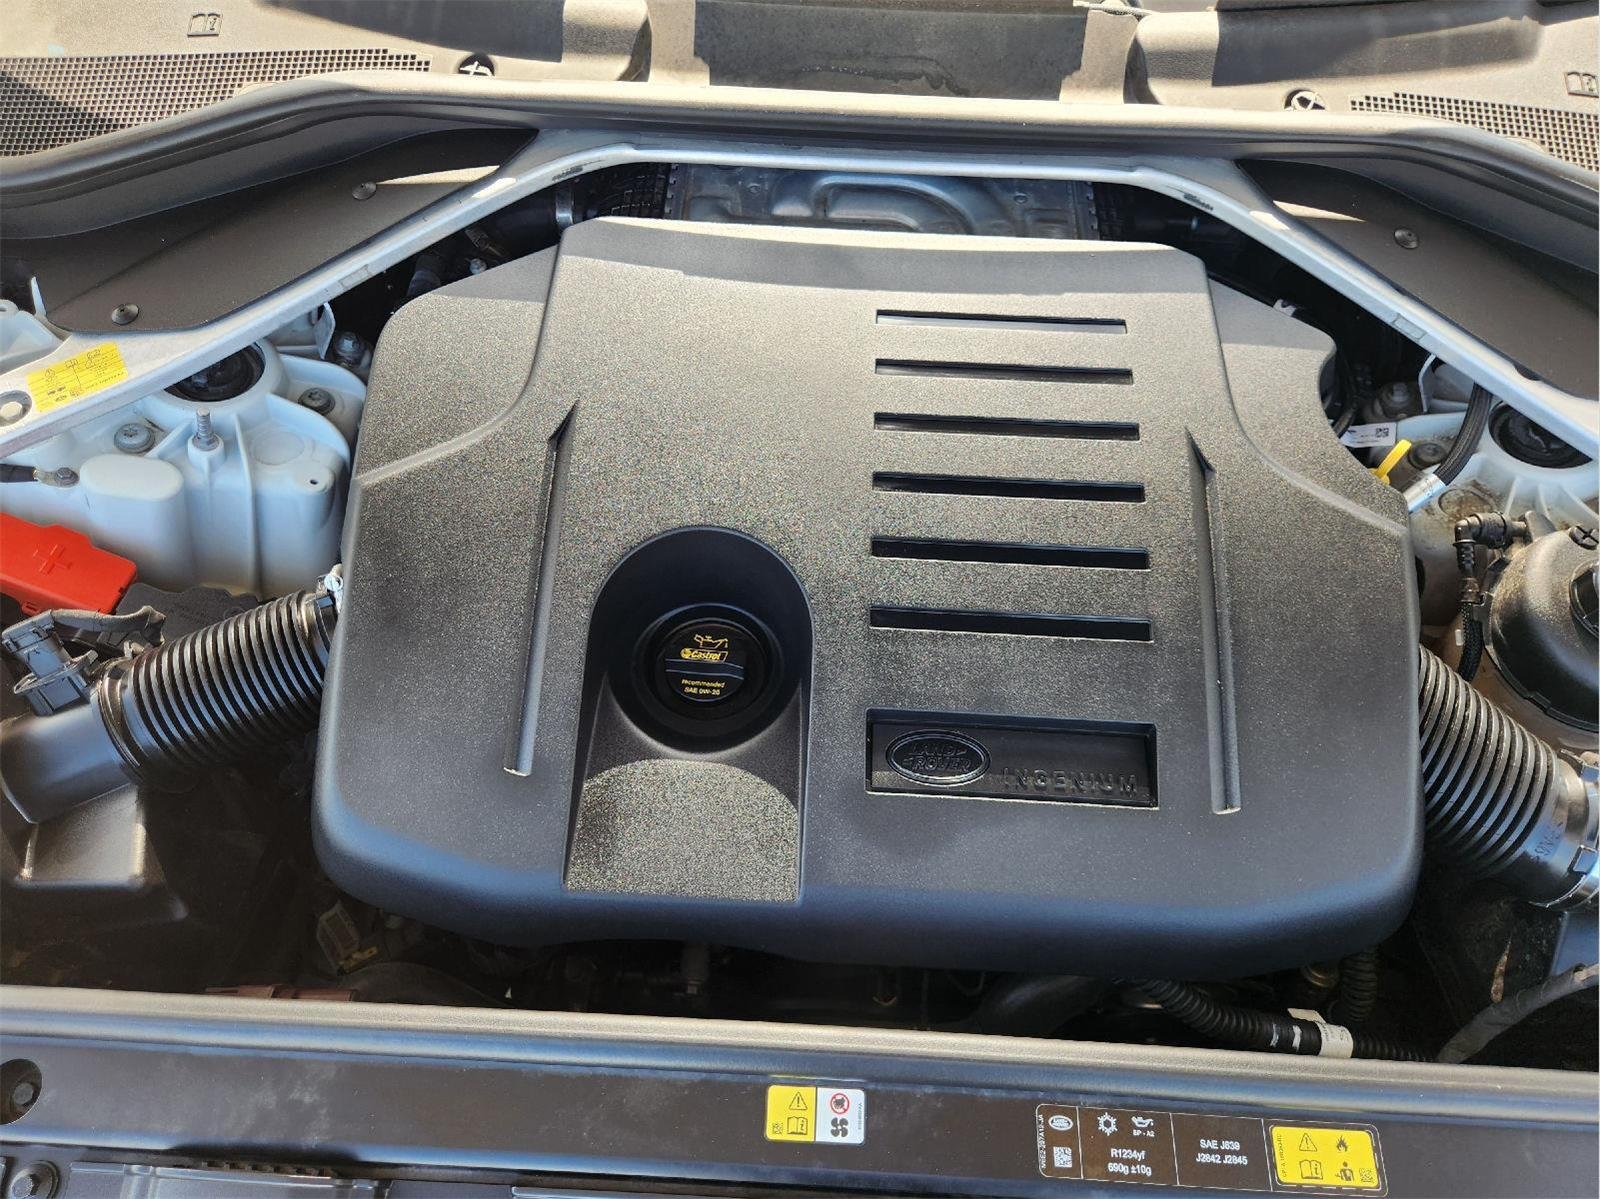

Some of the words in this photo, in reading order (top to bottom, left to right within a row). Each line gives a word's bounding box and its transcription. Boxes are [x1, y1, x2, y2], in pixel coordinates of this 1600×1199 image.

[691, 649, 721, 661] Castrol
[1002, 767, 1138, 794] INGENIUM
[1200, 1139, 1219, 1149] SAE
[1220, 1141, 1240, 1151] J639
[1110, 1148, 1146, 1161] R1234yf
[1196, 1153, 1221, 1164] J2842
[1223, 1154, 1248, 1165] J2845
[1108, 1162, 1129, 1175] 690g
[1131, 1164, 1152, 1176] ±10g
